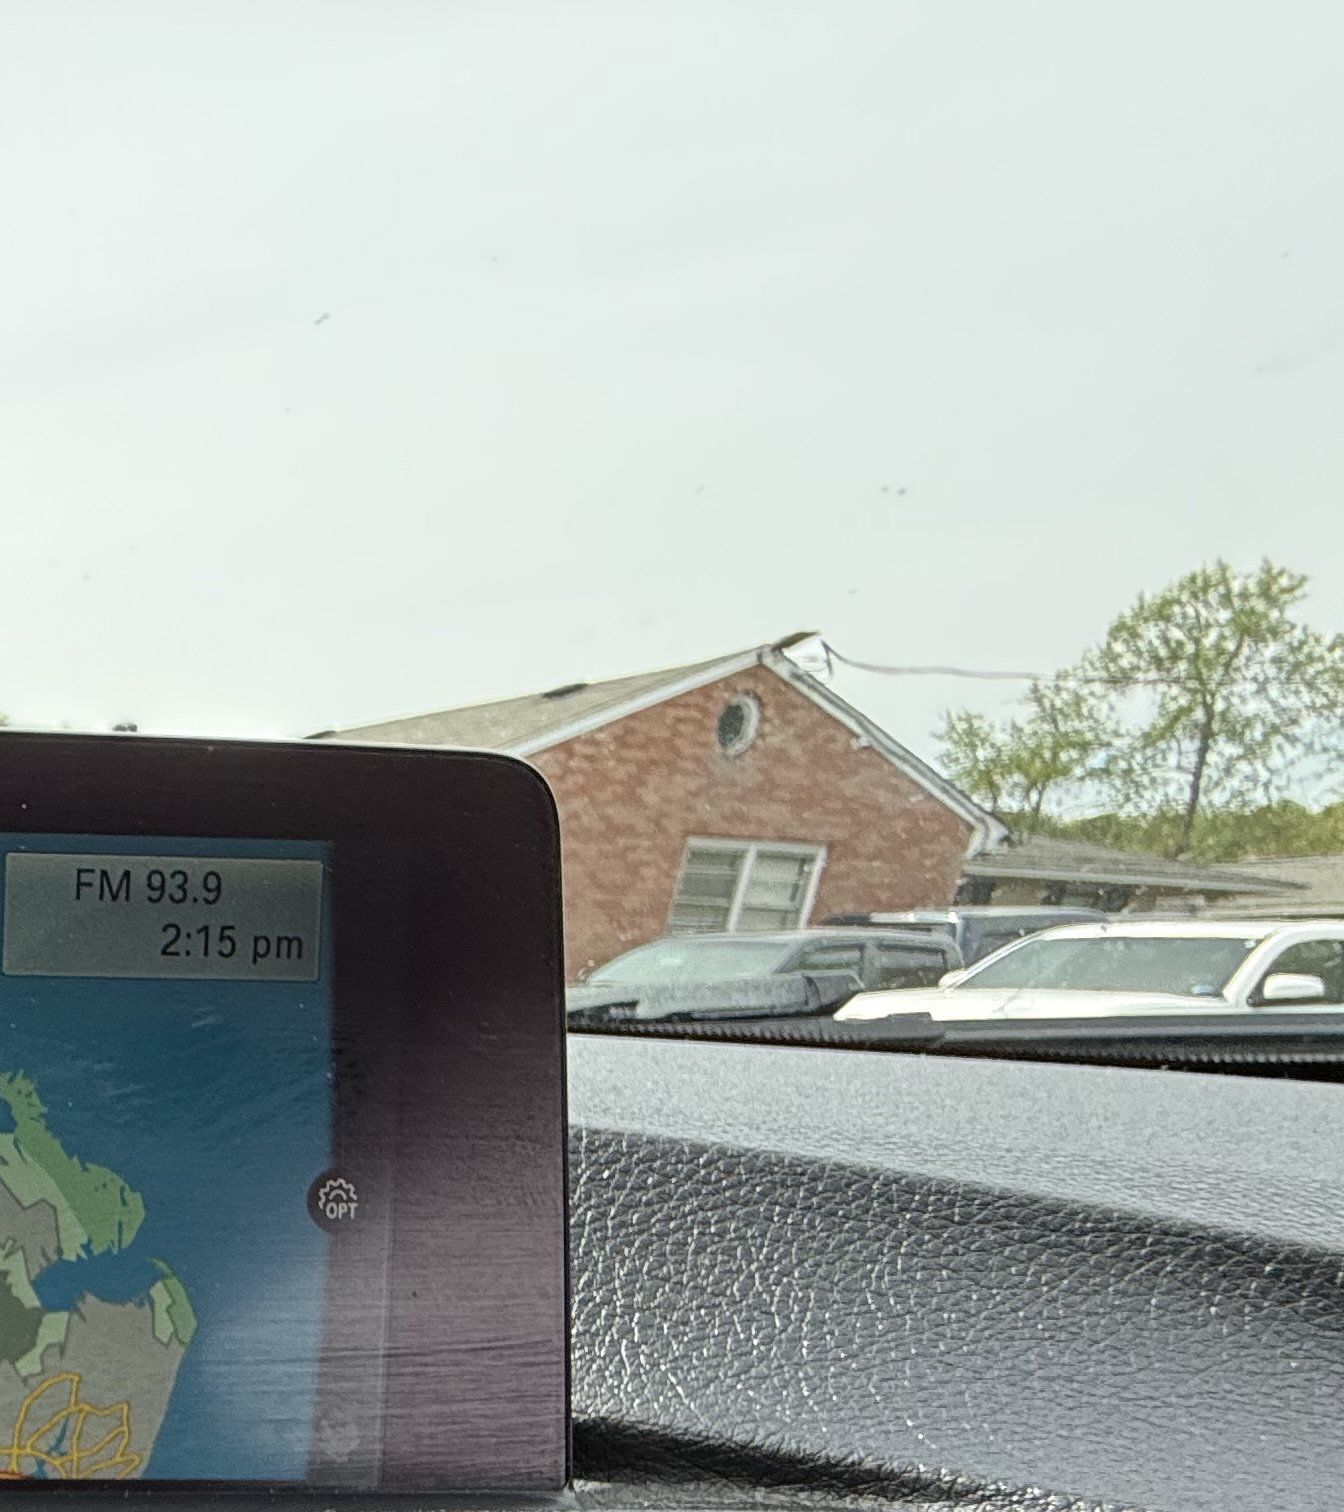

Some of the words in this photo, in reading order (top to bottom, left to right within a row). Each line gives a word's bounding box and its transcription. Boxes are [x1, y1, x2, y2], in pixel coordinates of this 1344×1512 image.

[75, 867, 132, 902] FM
[145, 869, 223, 905] 93.9
[160, 922, 237, 959] 2:15
[252, 933, 303, 965] pm
[325, 1201, 358, 1219] OPT
